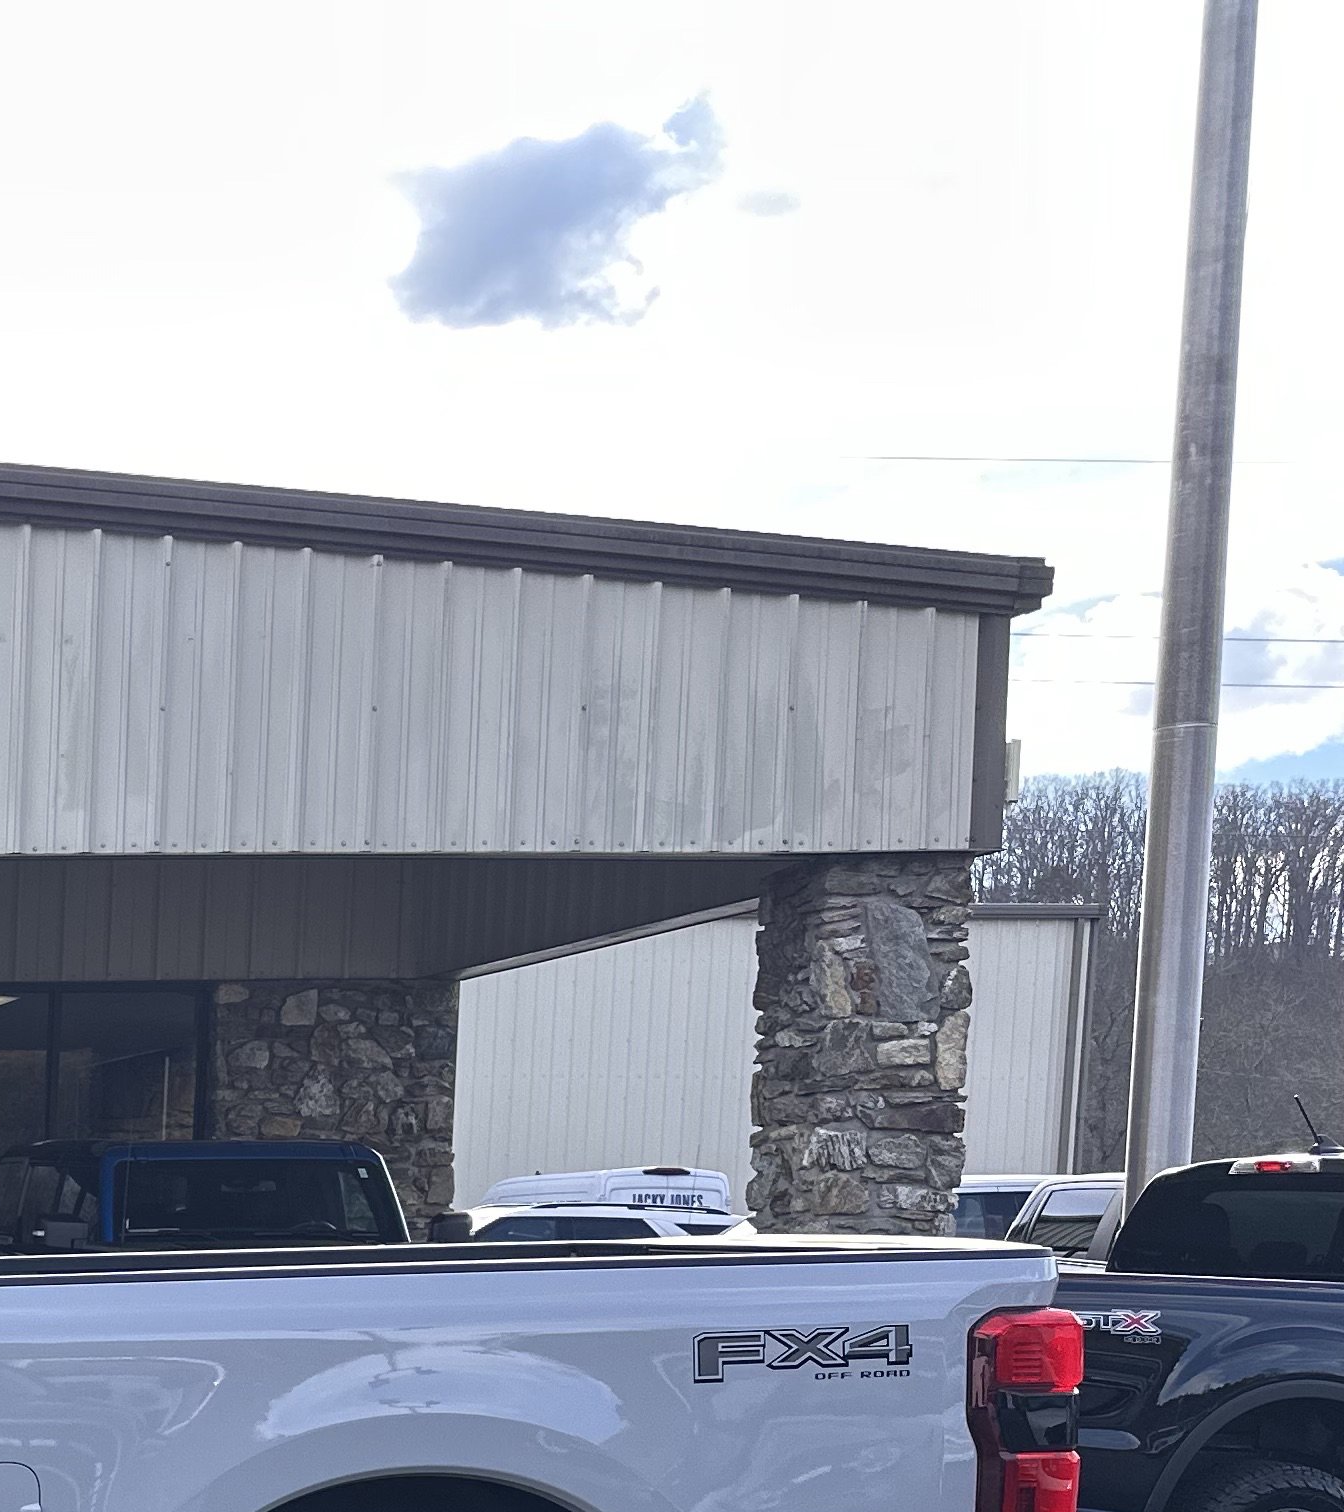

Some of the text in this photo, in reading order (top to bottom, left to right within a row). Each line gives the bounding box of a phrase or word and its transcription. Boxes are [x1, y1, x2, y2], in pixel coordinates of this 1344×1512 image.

[693, 1324, 913, 1384] FX4
[814, 1369, 911, 1381] OFF ROAD
